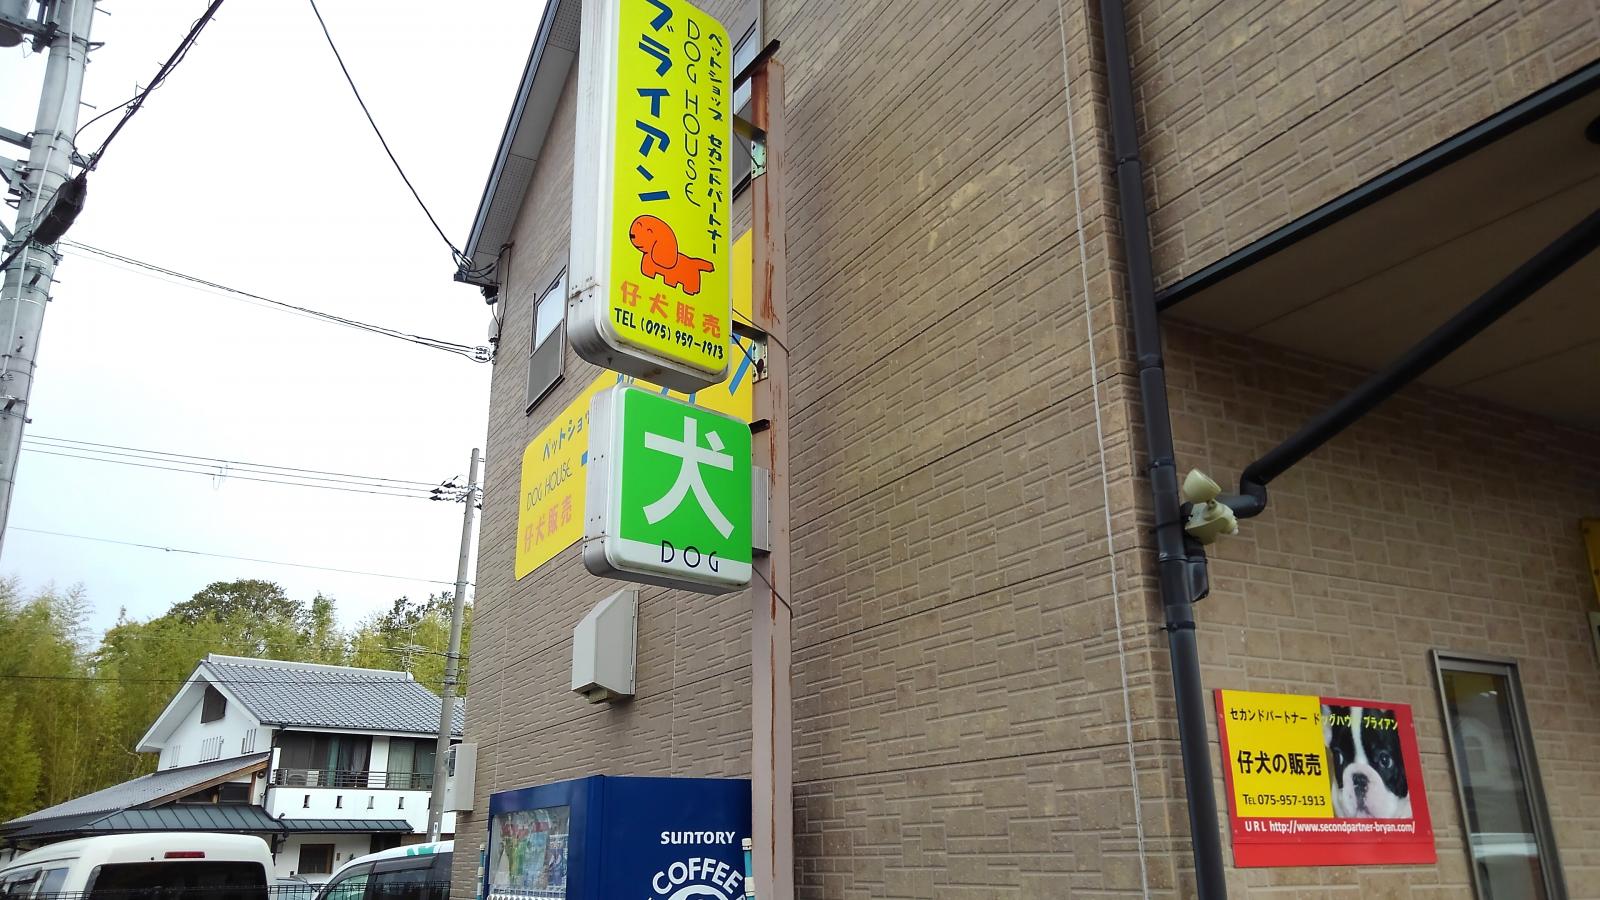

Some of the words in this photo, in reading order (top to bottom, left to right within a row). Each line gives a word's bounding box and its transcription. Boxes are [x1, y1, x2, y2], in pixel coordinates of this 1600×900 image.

[683, 18, 702, 85] DOG
[707, 33, 724, 122] ペットショップ
[682, 89, 702, 207] HOUSE
[707, 133, 723, 254] セカンドパートナー
[620, 280, 721, 339] 仔犬販売
[614, 307, 637, 329] TEL
[675, 330, 724, 360] 957-1913
[643, 416, 735, 540] 犬
[661, 540, 719, 573] DOG
[1230, 707, 1308, 724] セカンドパートナー
[1363, 715, 1398, 731] ブライアン
[1237, 749, 1322, 776] 仔犬の販売
[1257, 794, 1326, 806] 075-957-1913
[660, 831, 736, 845] SUNTORY
[1269, 820, 1416, 834] http://www.secondpartner-bryan.com/
[652, 857, 743, 895] COFFEE
